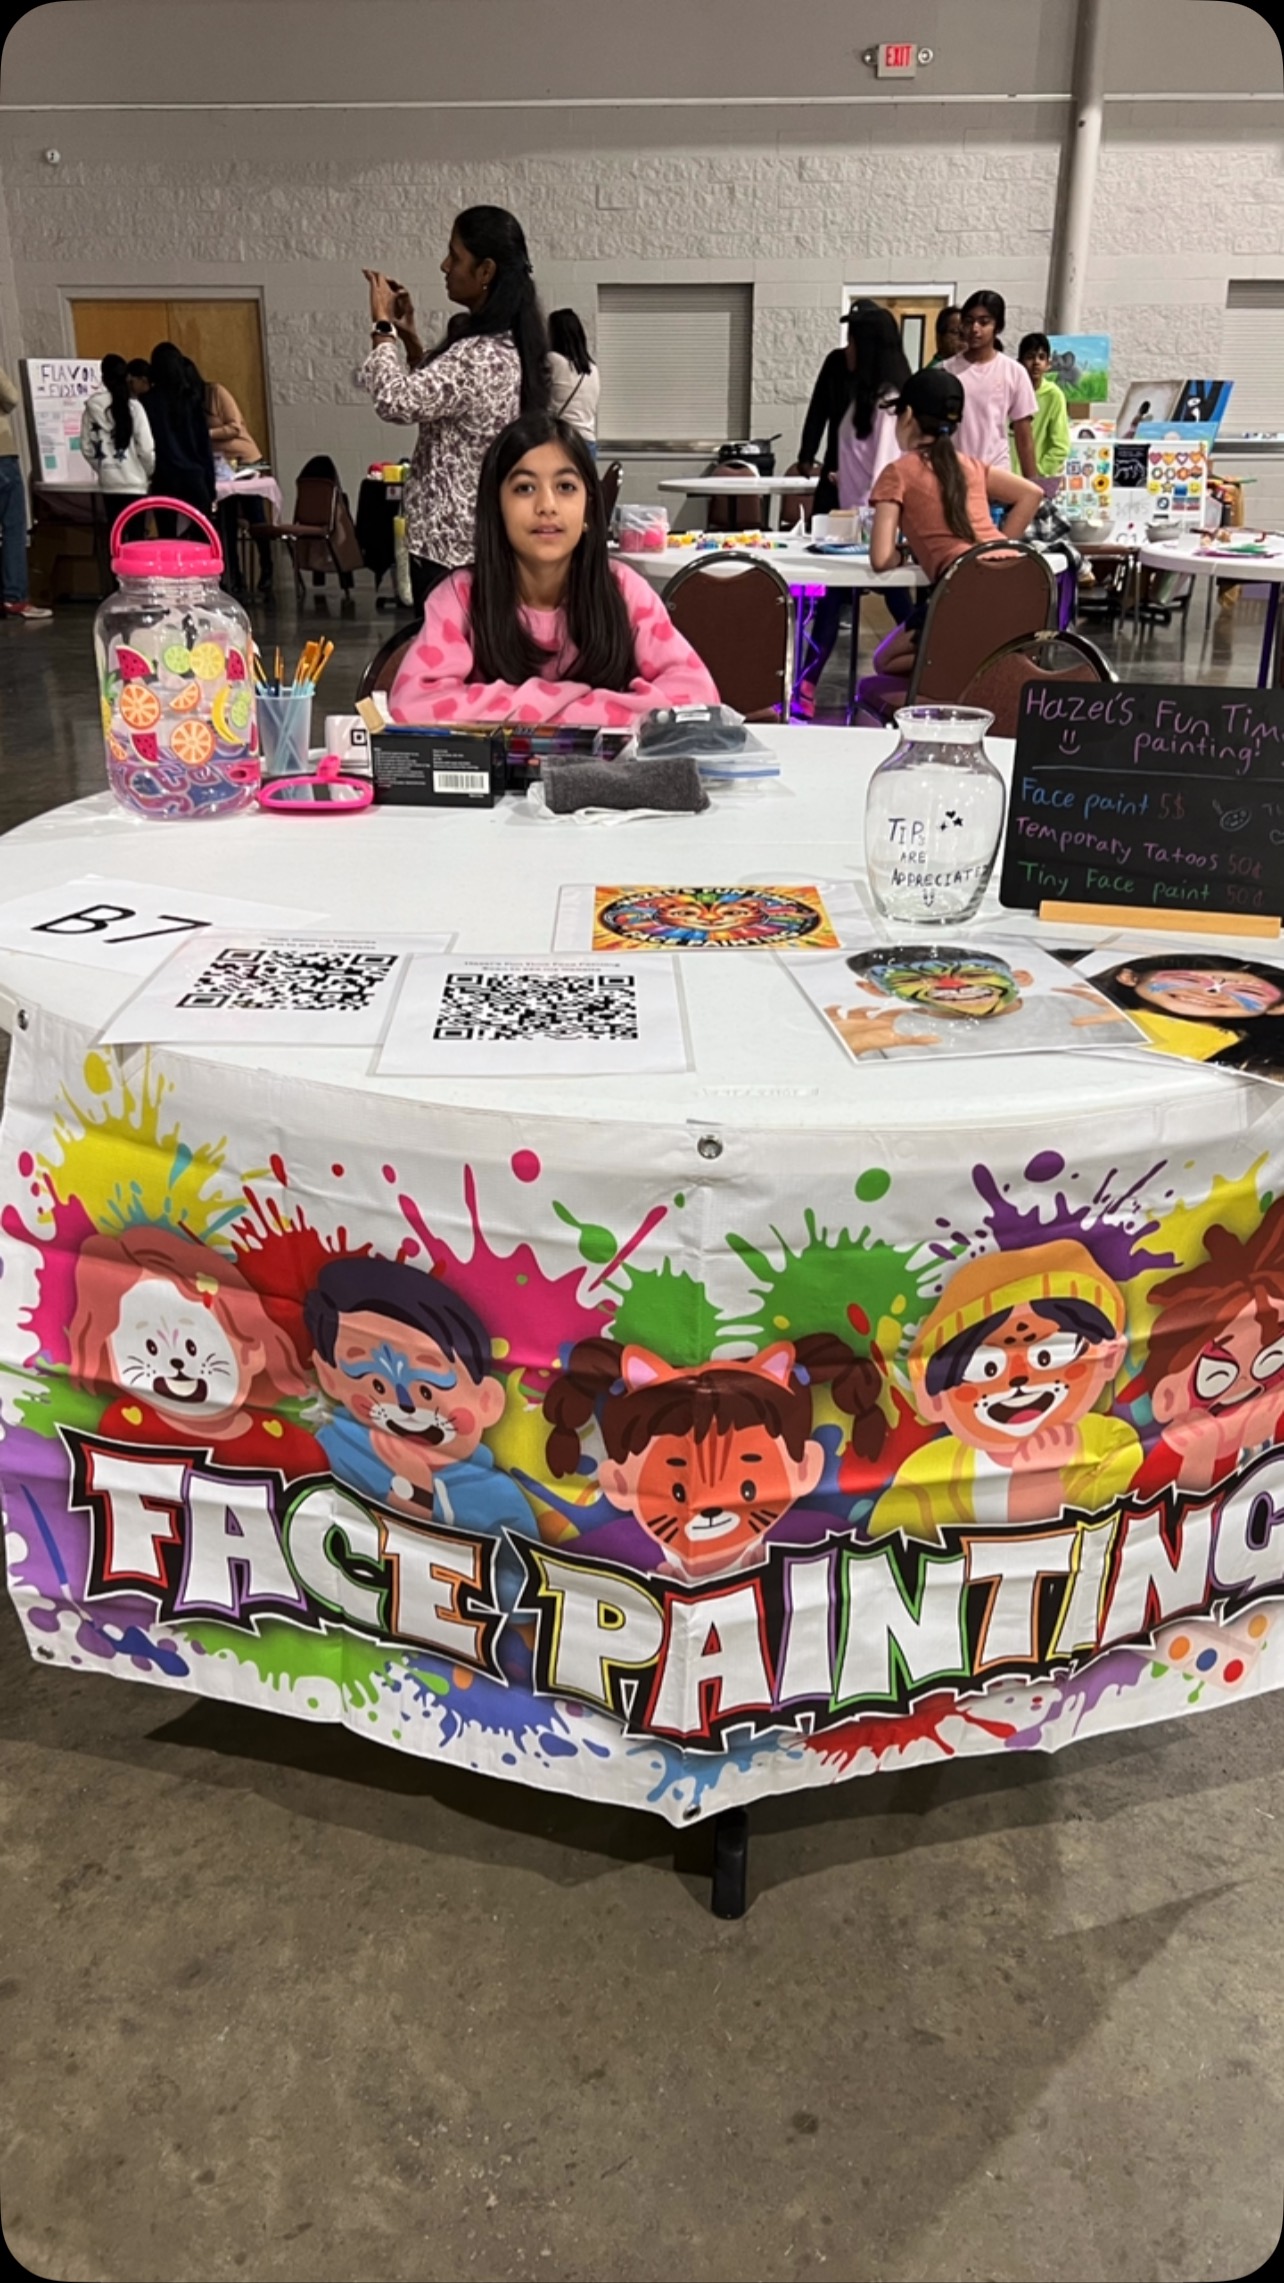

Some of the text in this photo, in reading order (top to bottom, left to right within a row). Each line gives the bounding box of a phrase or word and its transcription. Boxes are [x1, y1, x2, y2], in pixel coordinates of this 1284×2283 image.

[885, 45, 911, 67] EXIT
[1025, 687, 1135, 726] Hazel's
[1156, 700, 1210, 736] Fun
[1133, 732, 1262, 776] painting!
[1021, 776, 1076, 808] Face
[1083, 793, 1149, 820] paint
[900, 851, 926, 864] ARE
[1015, 816, 1132, 865] Temporary
[1143, 842, 1219, 872] Tatoos
[1017, 860, 1069, 897] Tiny
[1086, 867, 1135, 893] Face
[1152, 879, 1211, 903] paint
[30, 903, 213, 944] B7
[80, 1441, 1284, 1739] FACE PAINTING
